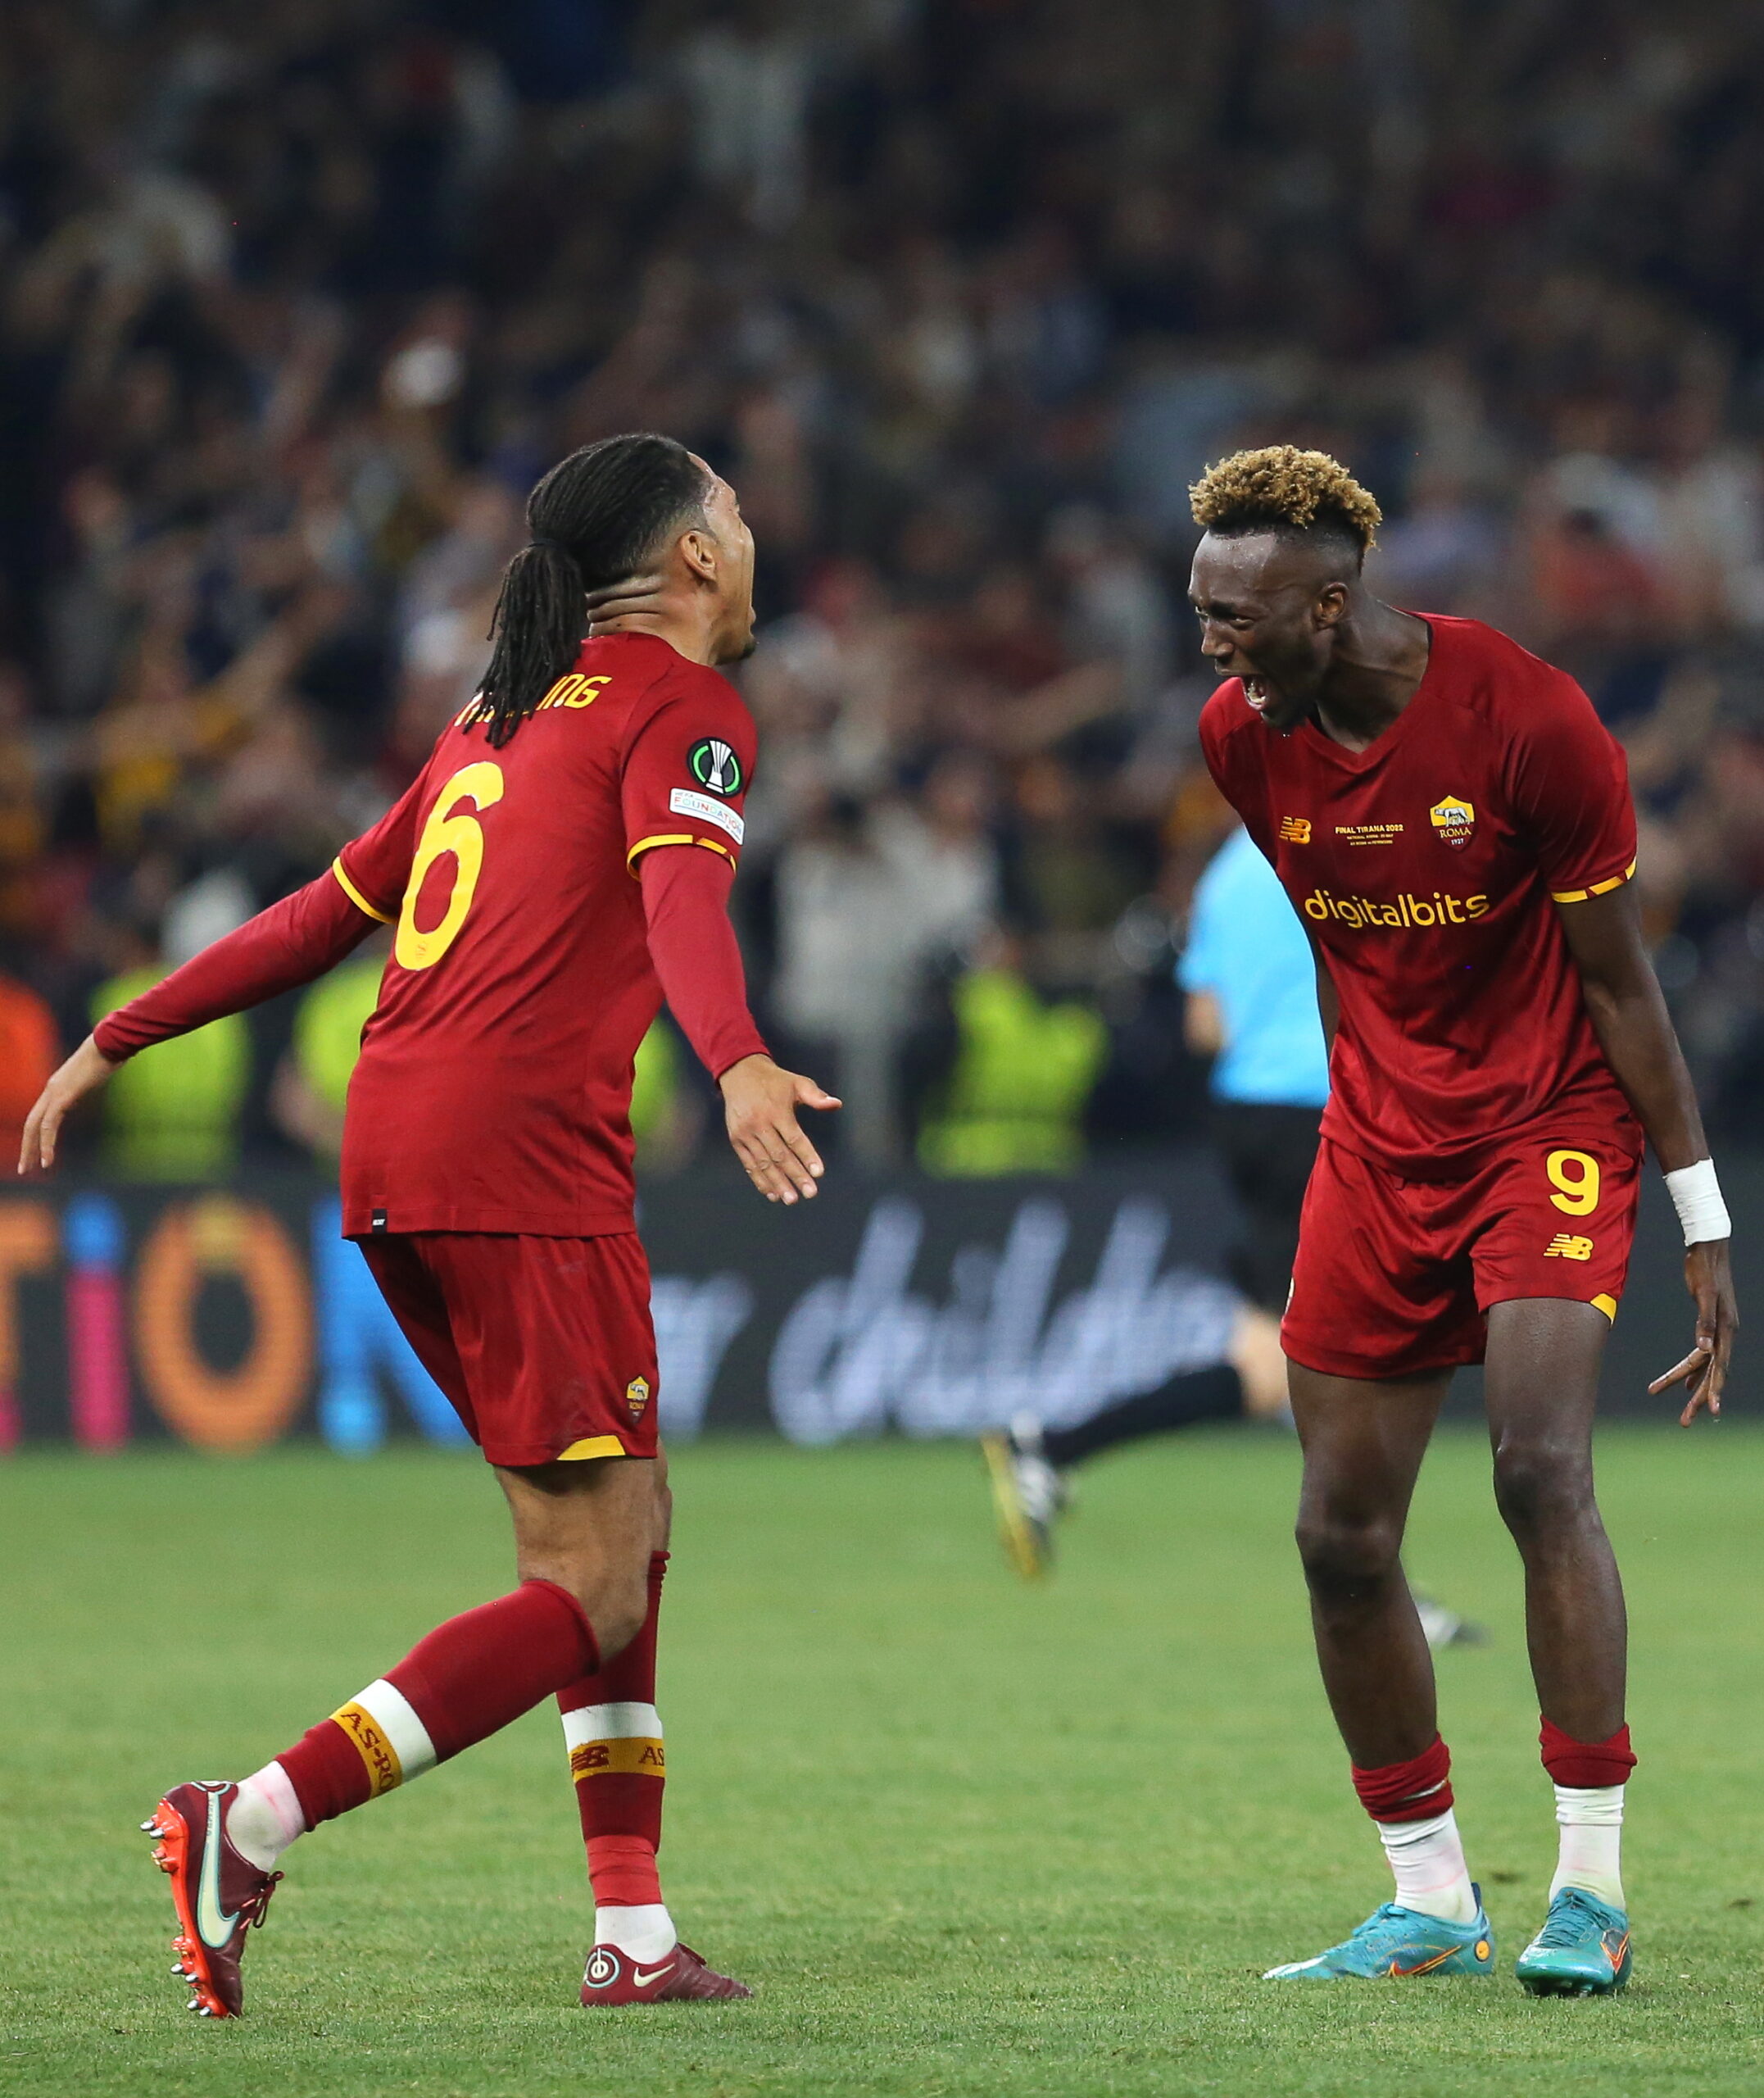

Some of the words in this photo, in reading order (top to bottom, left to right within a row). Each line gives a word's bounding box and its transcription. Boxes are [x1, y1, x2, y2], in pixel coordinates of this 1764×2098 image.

[1335, 826, 1356, 834] FINAL
[1356, 824, 1385, 833] TIRANA
[1385, 824, 1404, 832] 2022
[1440, 827, 1472, 838] ROMA
[395, 761, 504, 971] 6
[1304, 889, 1490, 929] digitalbits
[1546, 1150, 1600, 1216] 9
